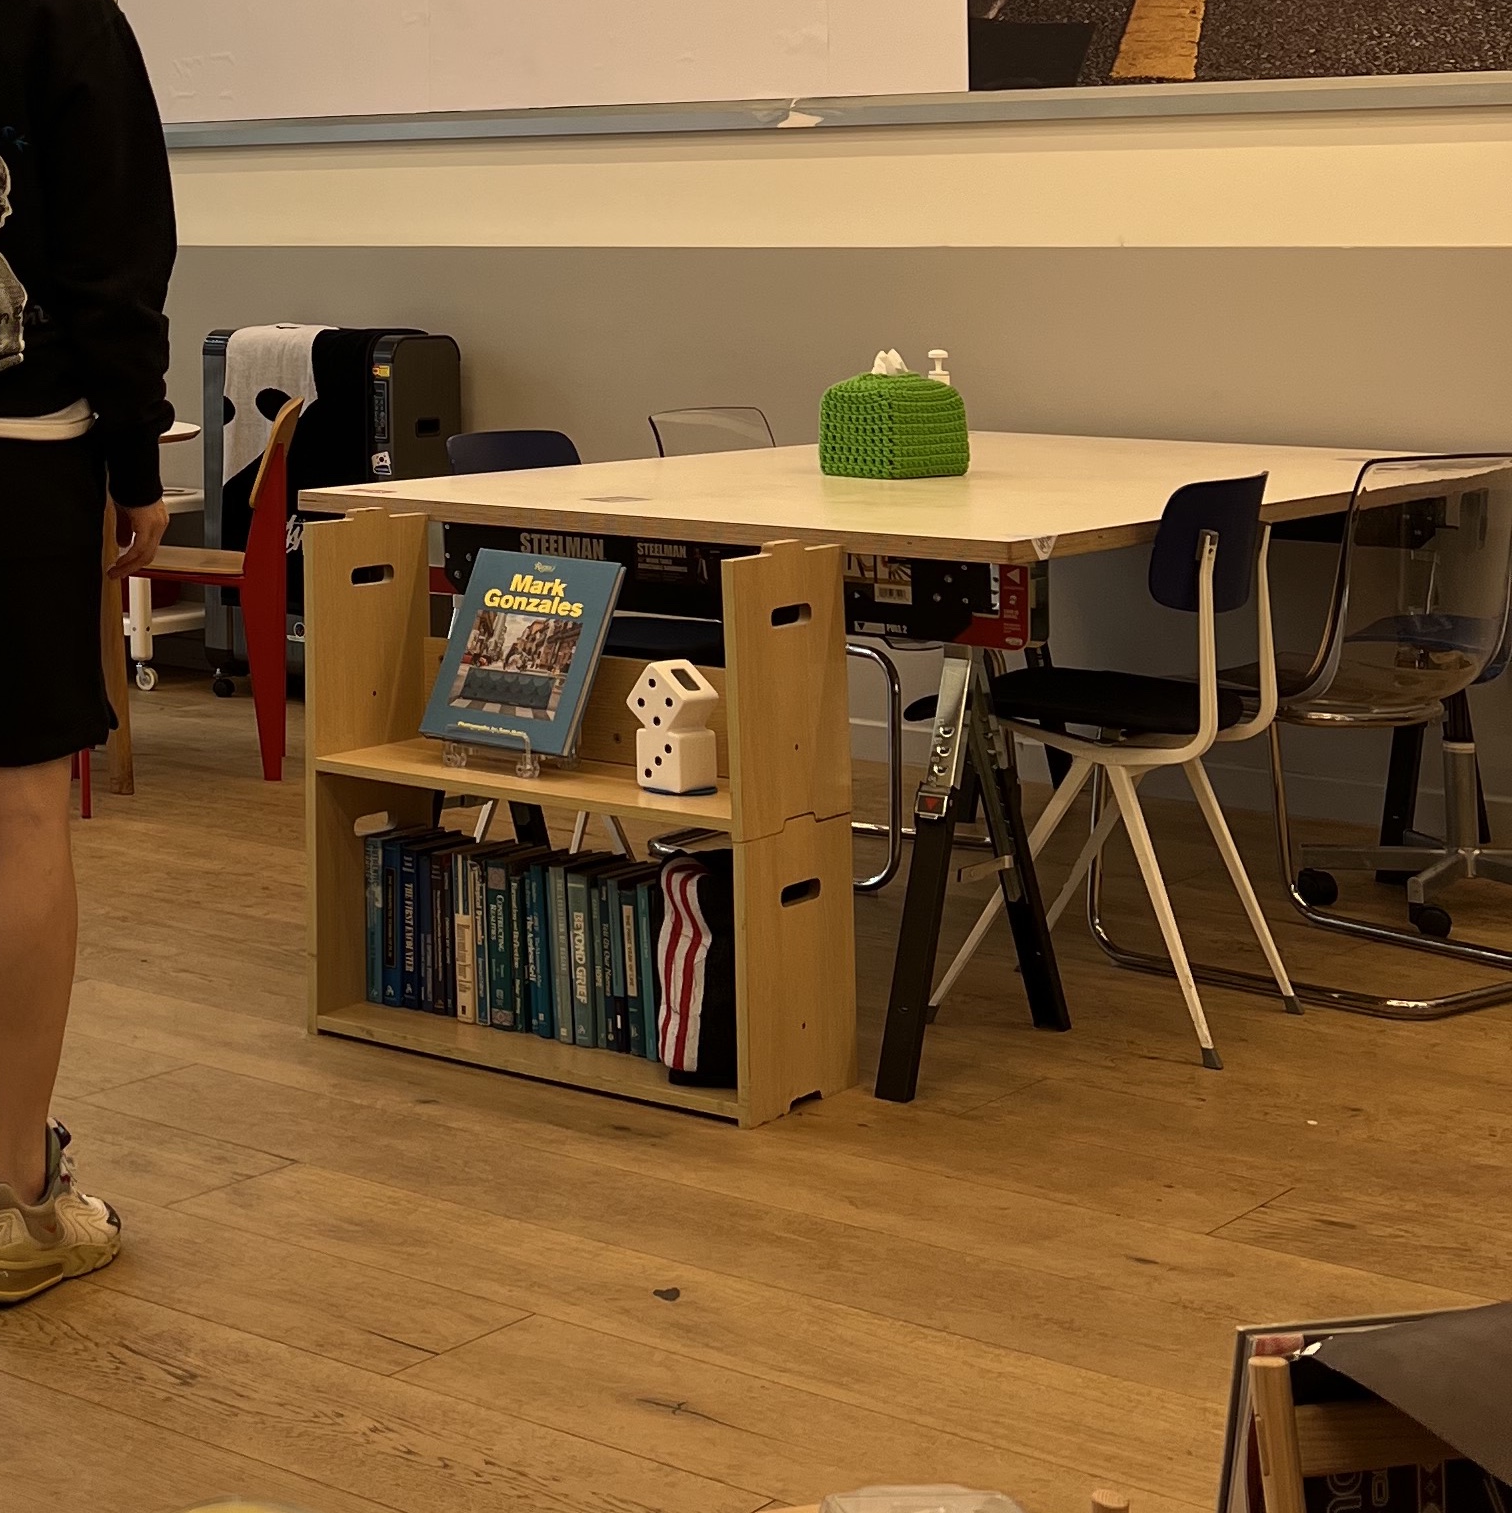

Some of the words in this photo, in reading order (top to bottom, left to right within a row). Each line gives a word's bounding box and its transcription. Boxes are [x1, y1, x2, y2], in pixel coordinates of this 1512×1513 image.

[520, 533, 605, 560] STEELMAN
[637, 542, 688, 559] STEELMAN
[509, 573, 568, 597] Mark
[483, 588, 584, 618] Gonzales
[573, 912, 586, 964] BEYOND
[575, 966, 588, 1004] GRIEF
